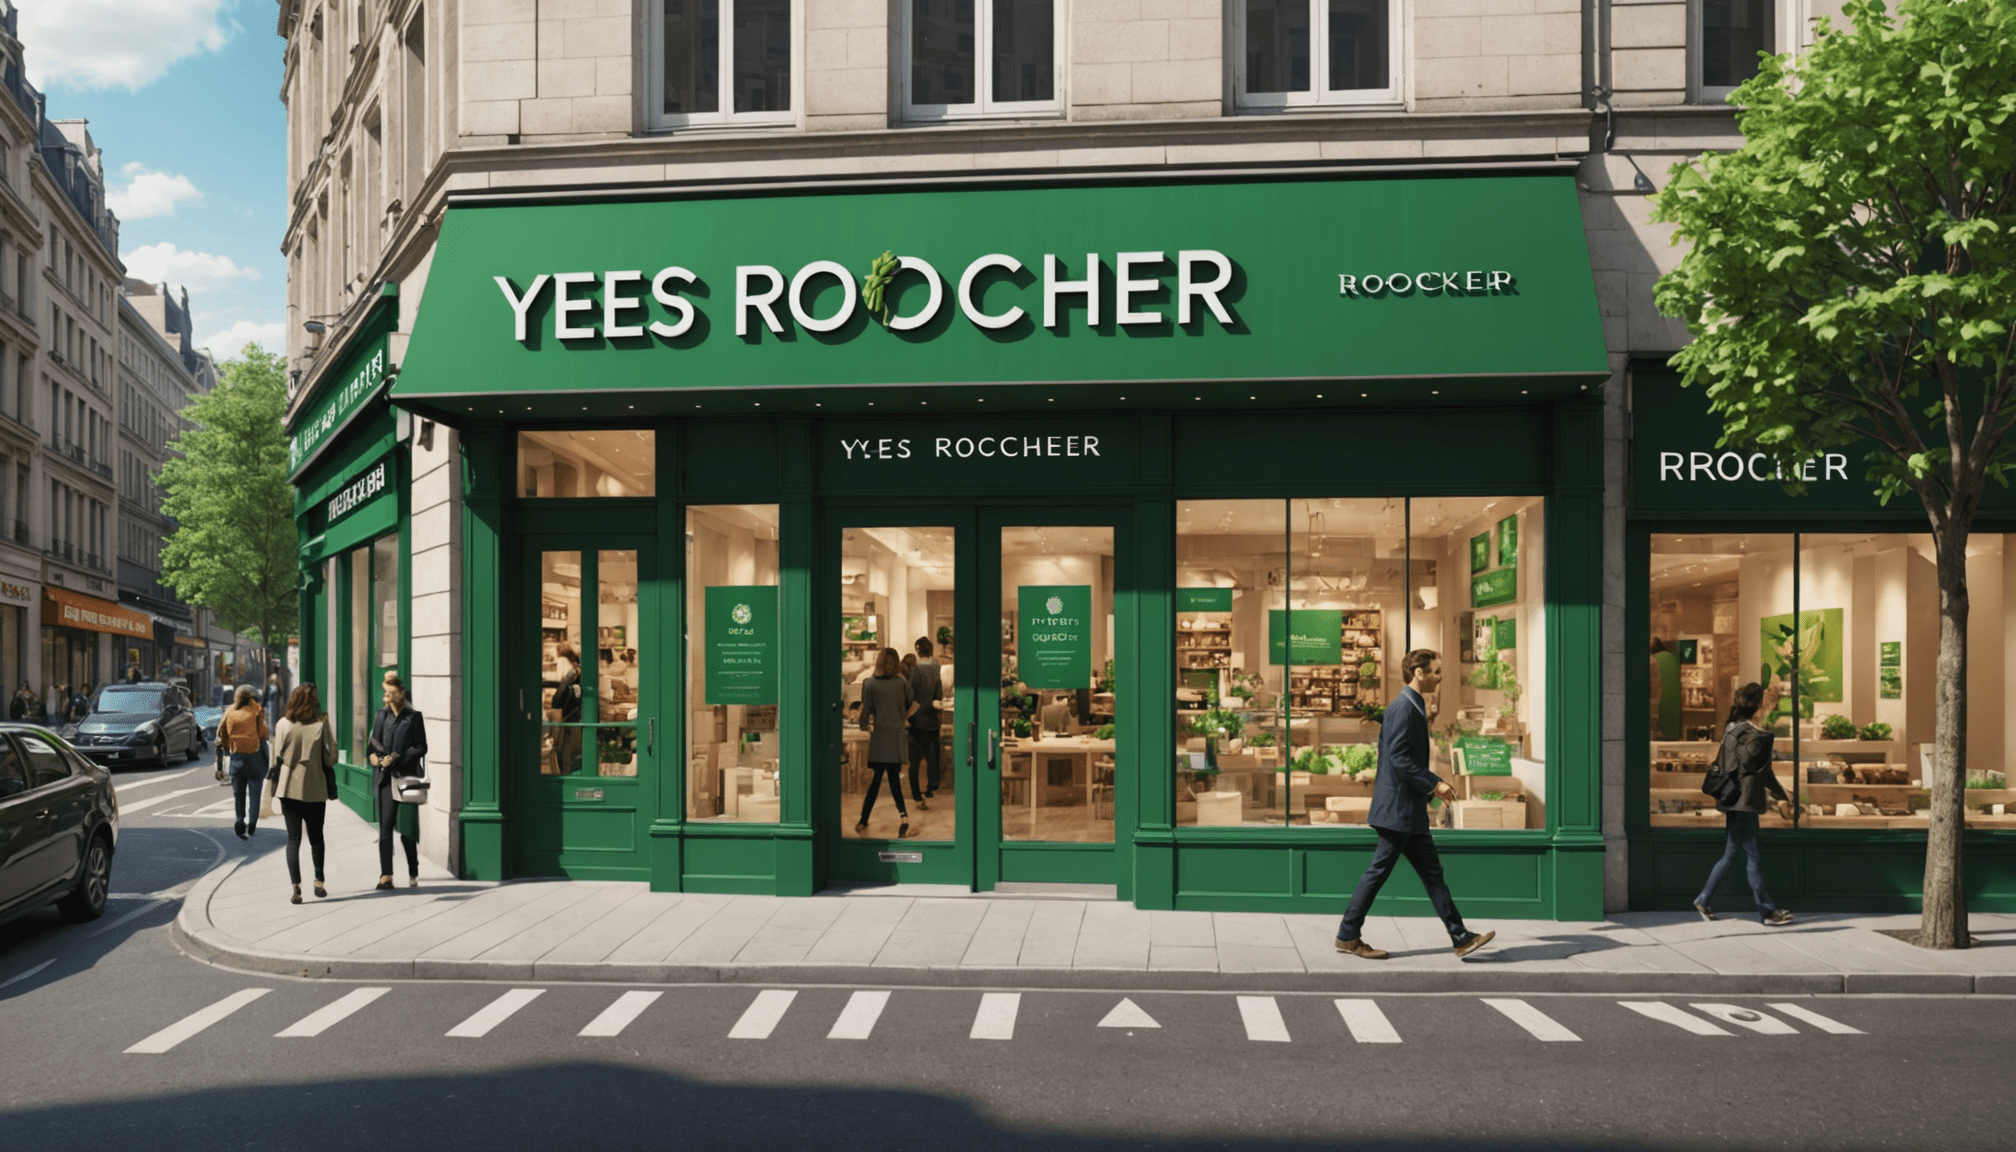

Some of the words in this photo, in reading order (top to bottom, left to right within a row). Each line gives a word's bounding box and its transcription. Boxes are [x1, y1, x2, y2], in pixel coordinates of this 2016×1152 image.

[493, 266, 697, 342] YEES
[736, 249, 1233, 336] ROOCHER
[935, 436, 1100, 458] ROCCHEER
